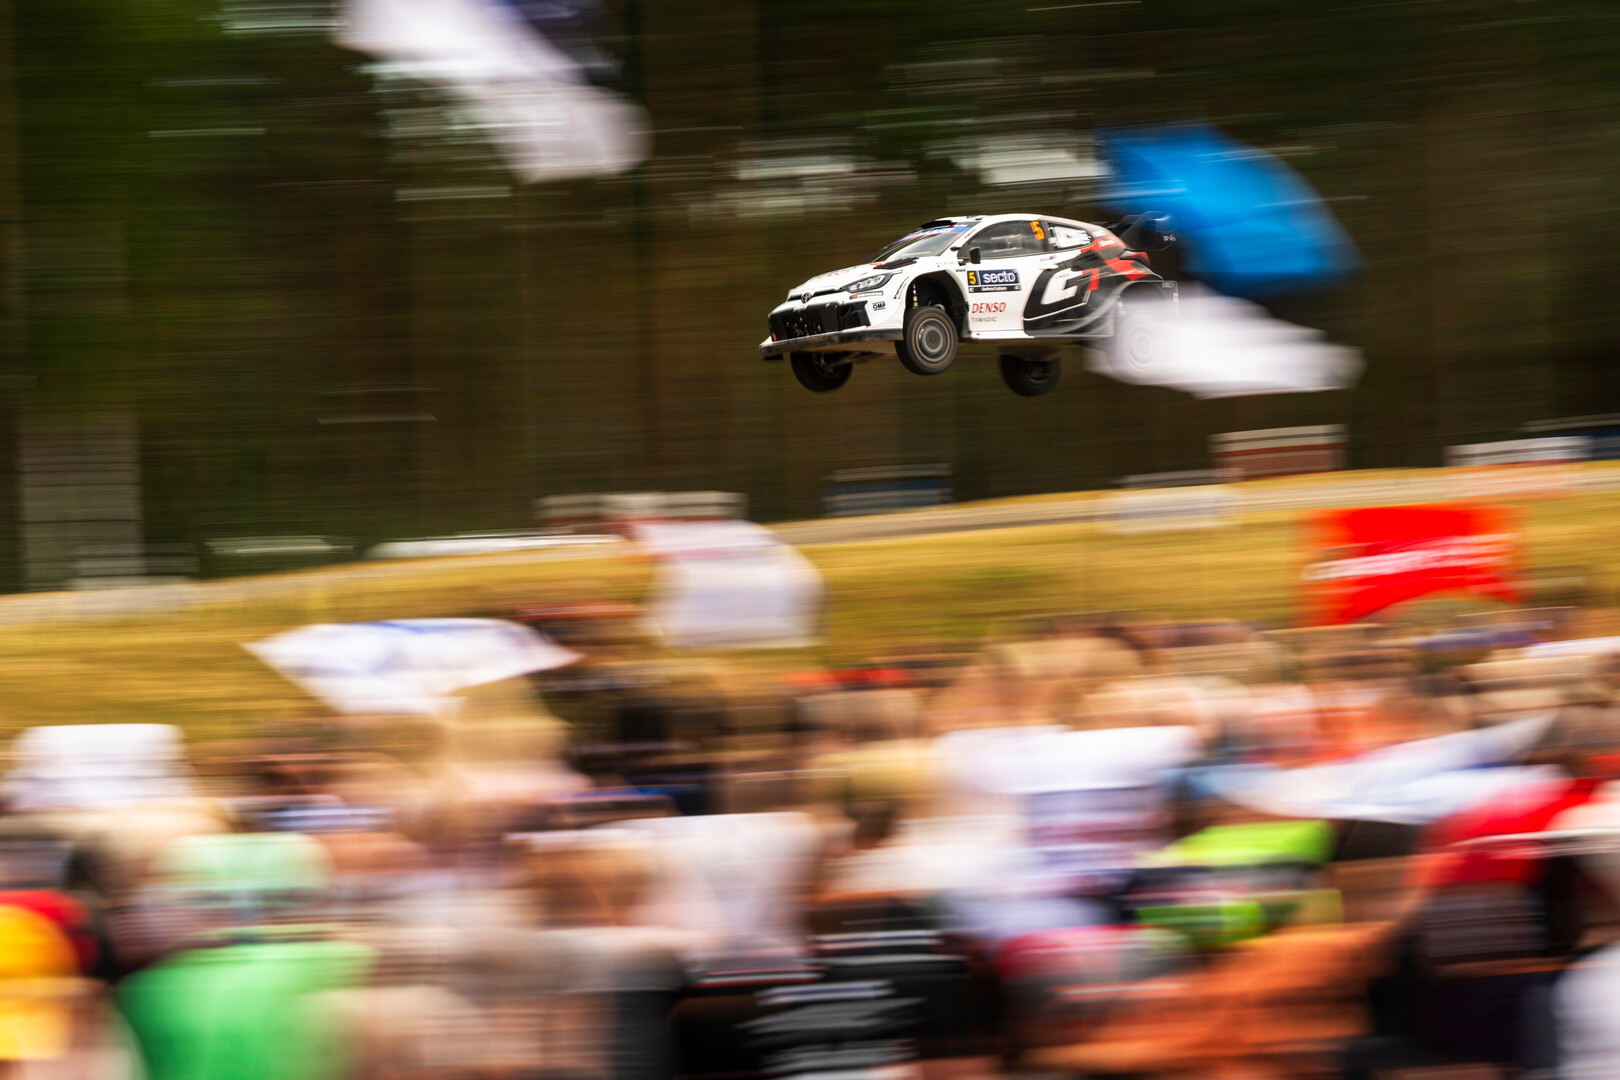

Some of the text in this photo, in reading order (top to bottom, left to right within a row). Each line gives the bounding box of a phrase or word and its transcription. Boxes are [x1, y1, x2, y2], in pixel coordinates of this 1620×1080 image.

[1030, 221, 1045, 240] 5
[969, 272, 976, 284] 5
[983, 271, 1016, 284] secto
[872, 302, 886, 310] OMP
[972, 302, 1006, 314] DENSO
